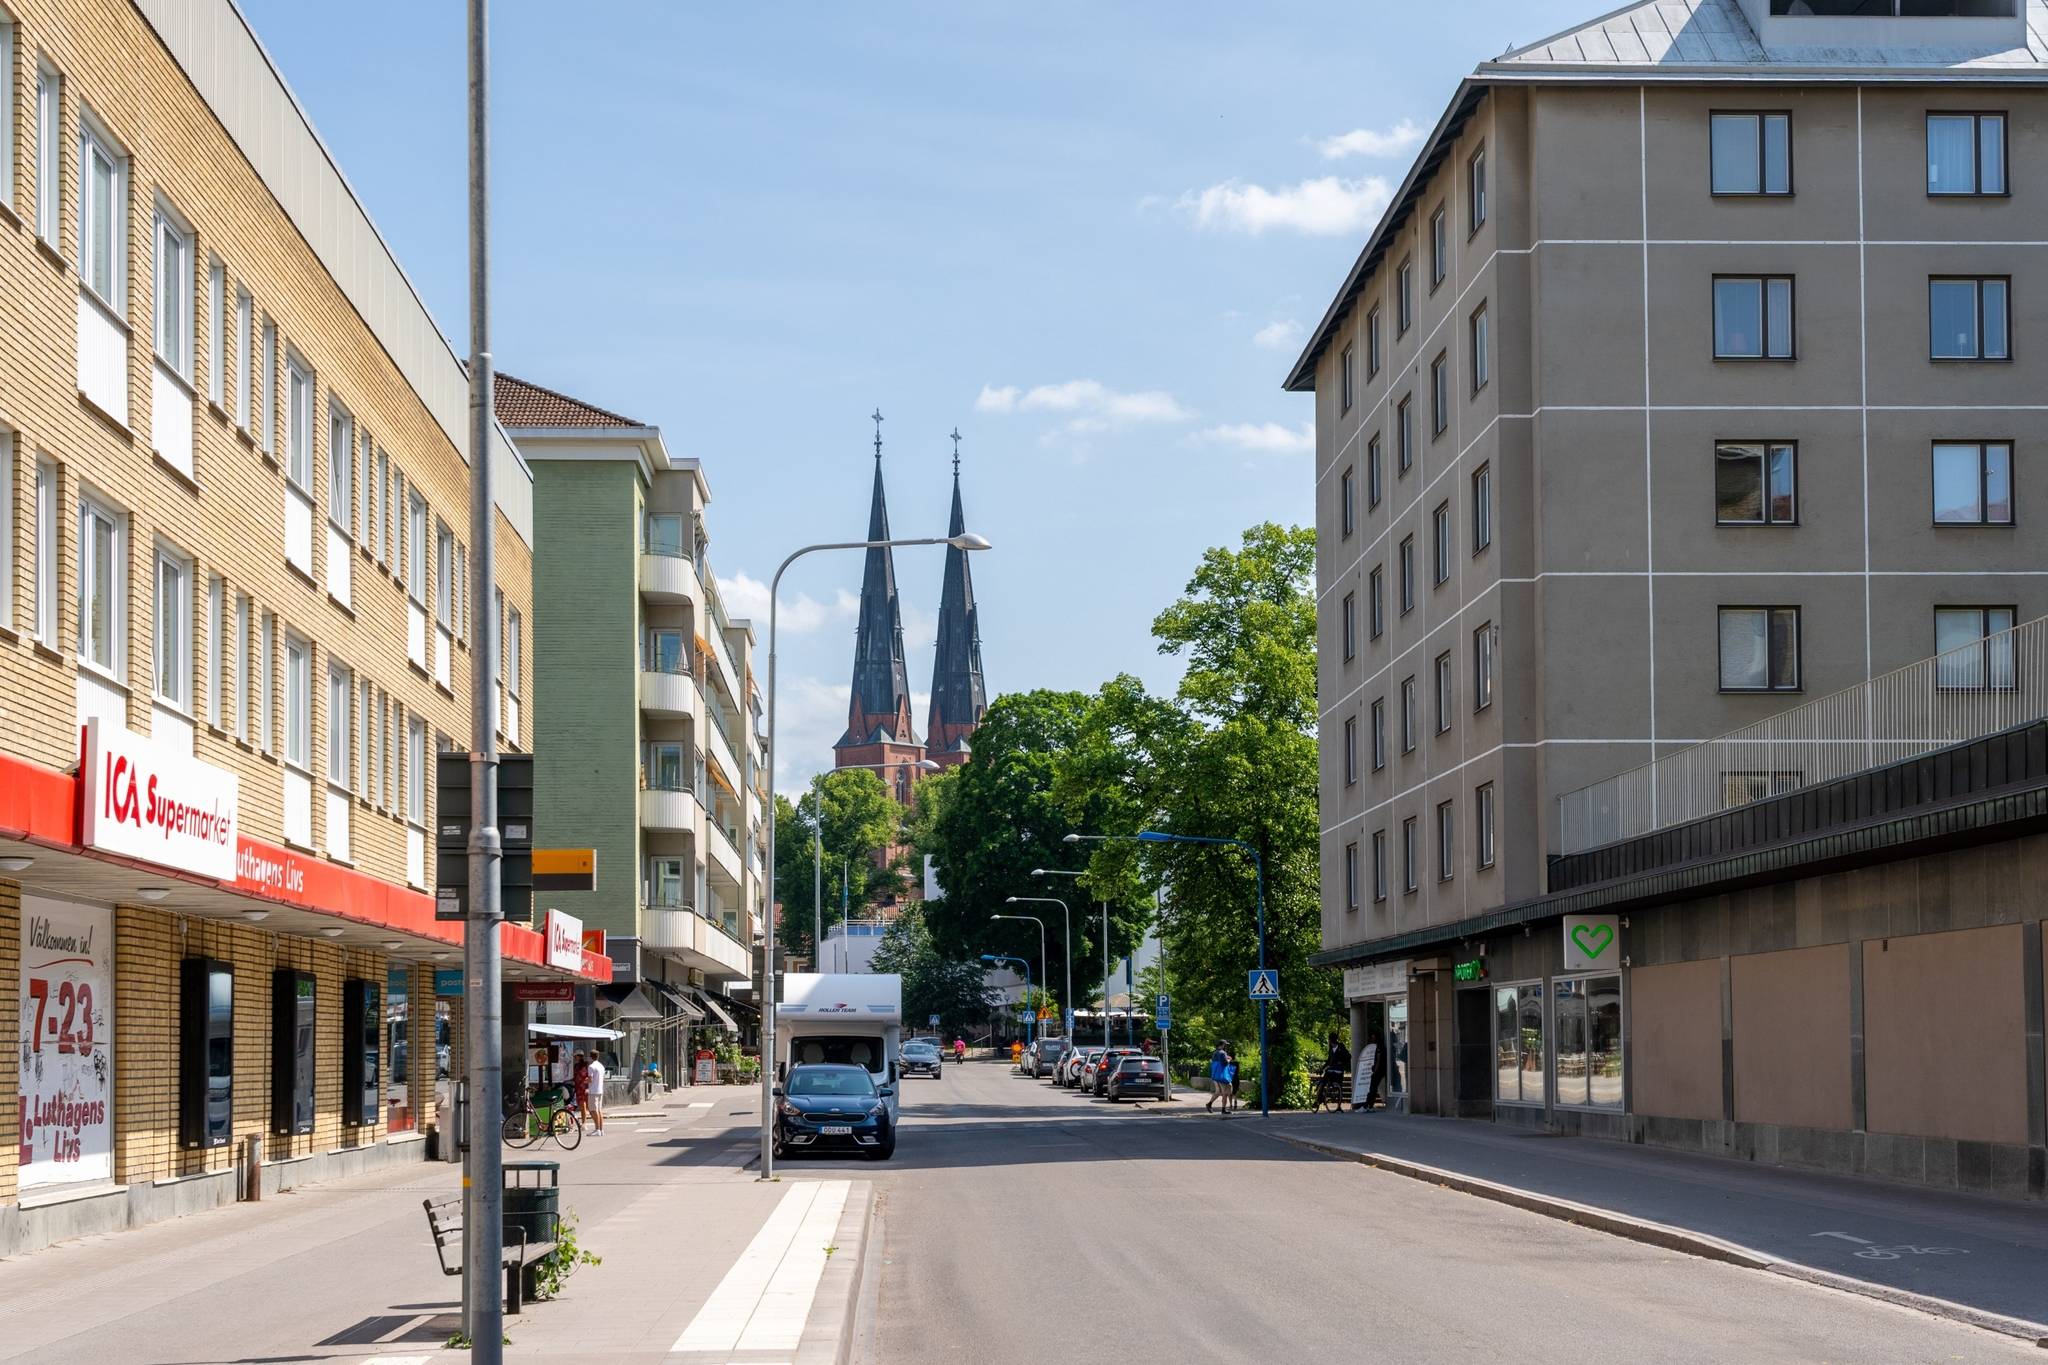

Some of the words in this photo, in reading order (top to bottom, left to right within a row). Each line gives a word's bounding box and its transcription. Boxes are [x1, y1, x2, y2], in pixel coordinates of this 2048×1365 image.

[105, 751, 141, 828] ICA
[146, 773, 231, 847] Supermarket
[236, 846, 284, 893] uthagens
[286, 859, 304, 893] Livs
[29, 915, 77, 953] Välkommen
[80, 924, 94, 955] in!
[30, 978, 93, 1057] 7-23
[1160, 996, 1168, 1007] P
[33, 1094, 105, 1135] Luthagens
[53, 1130, 81, 1162] Livs
